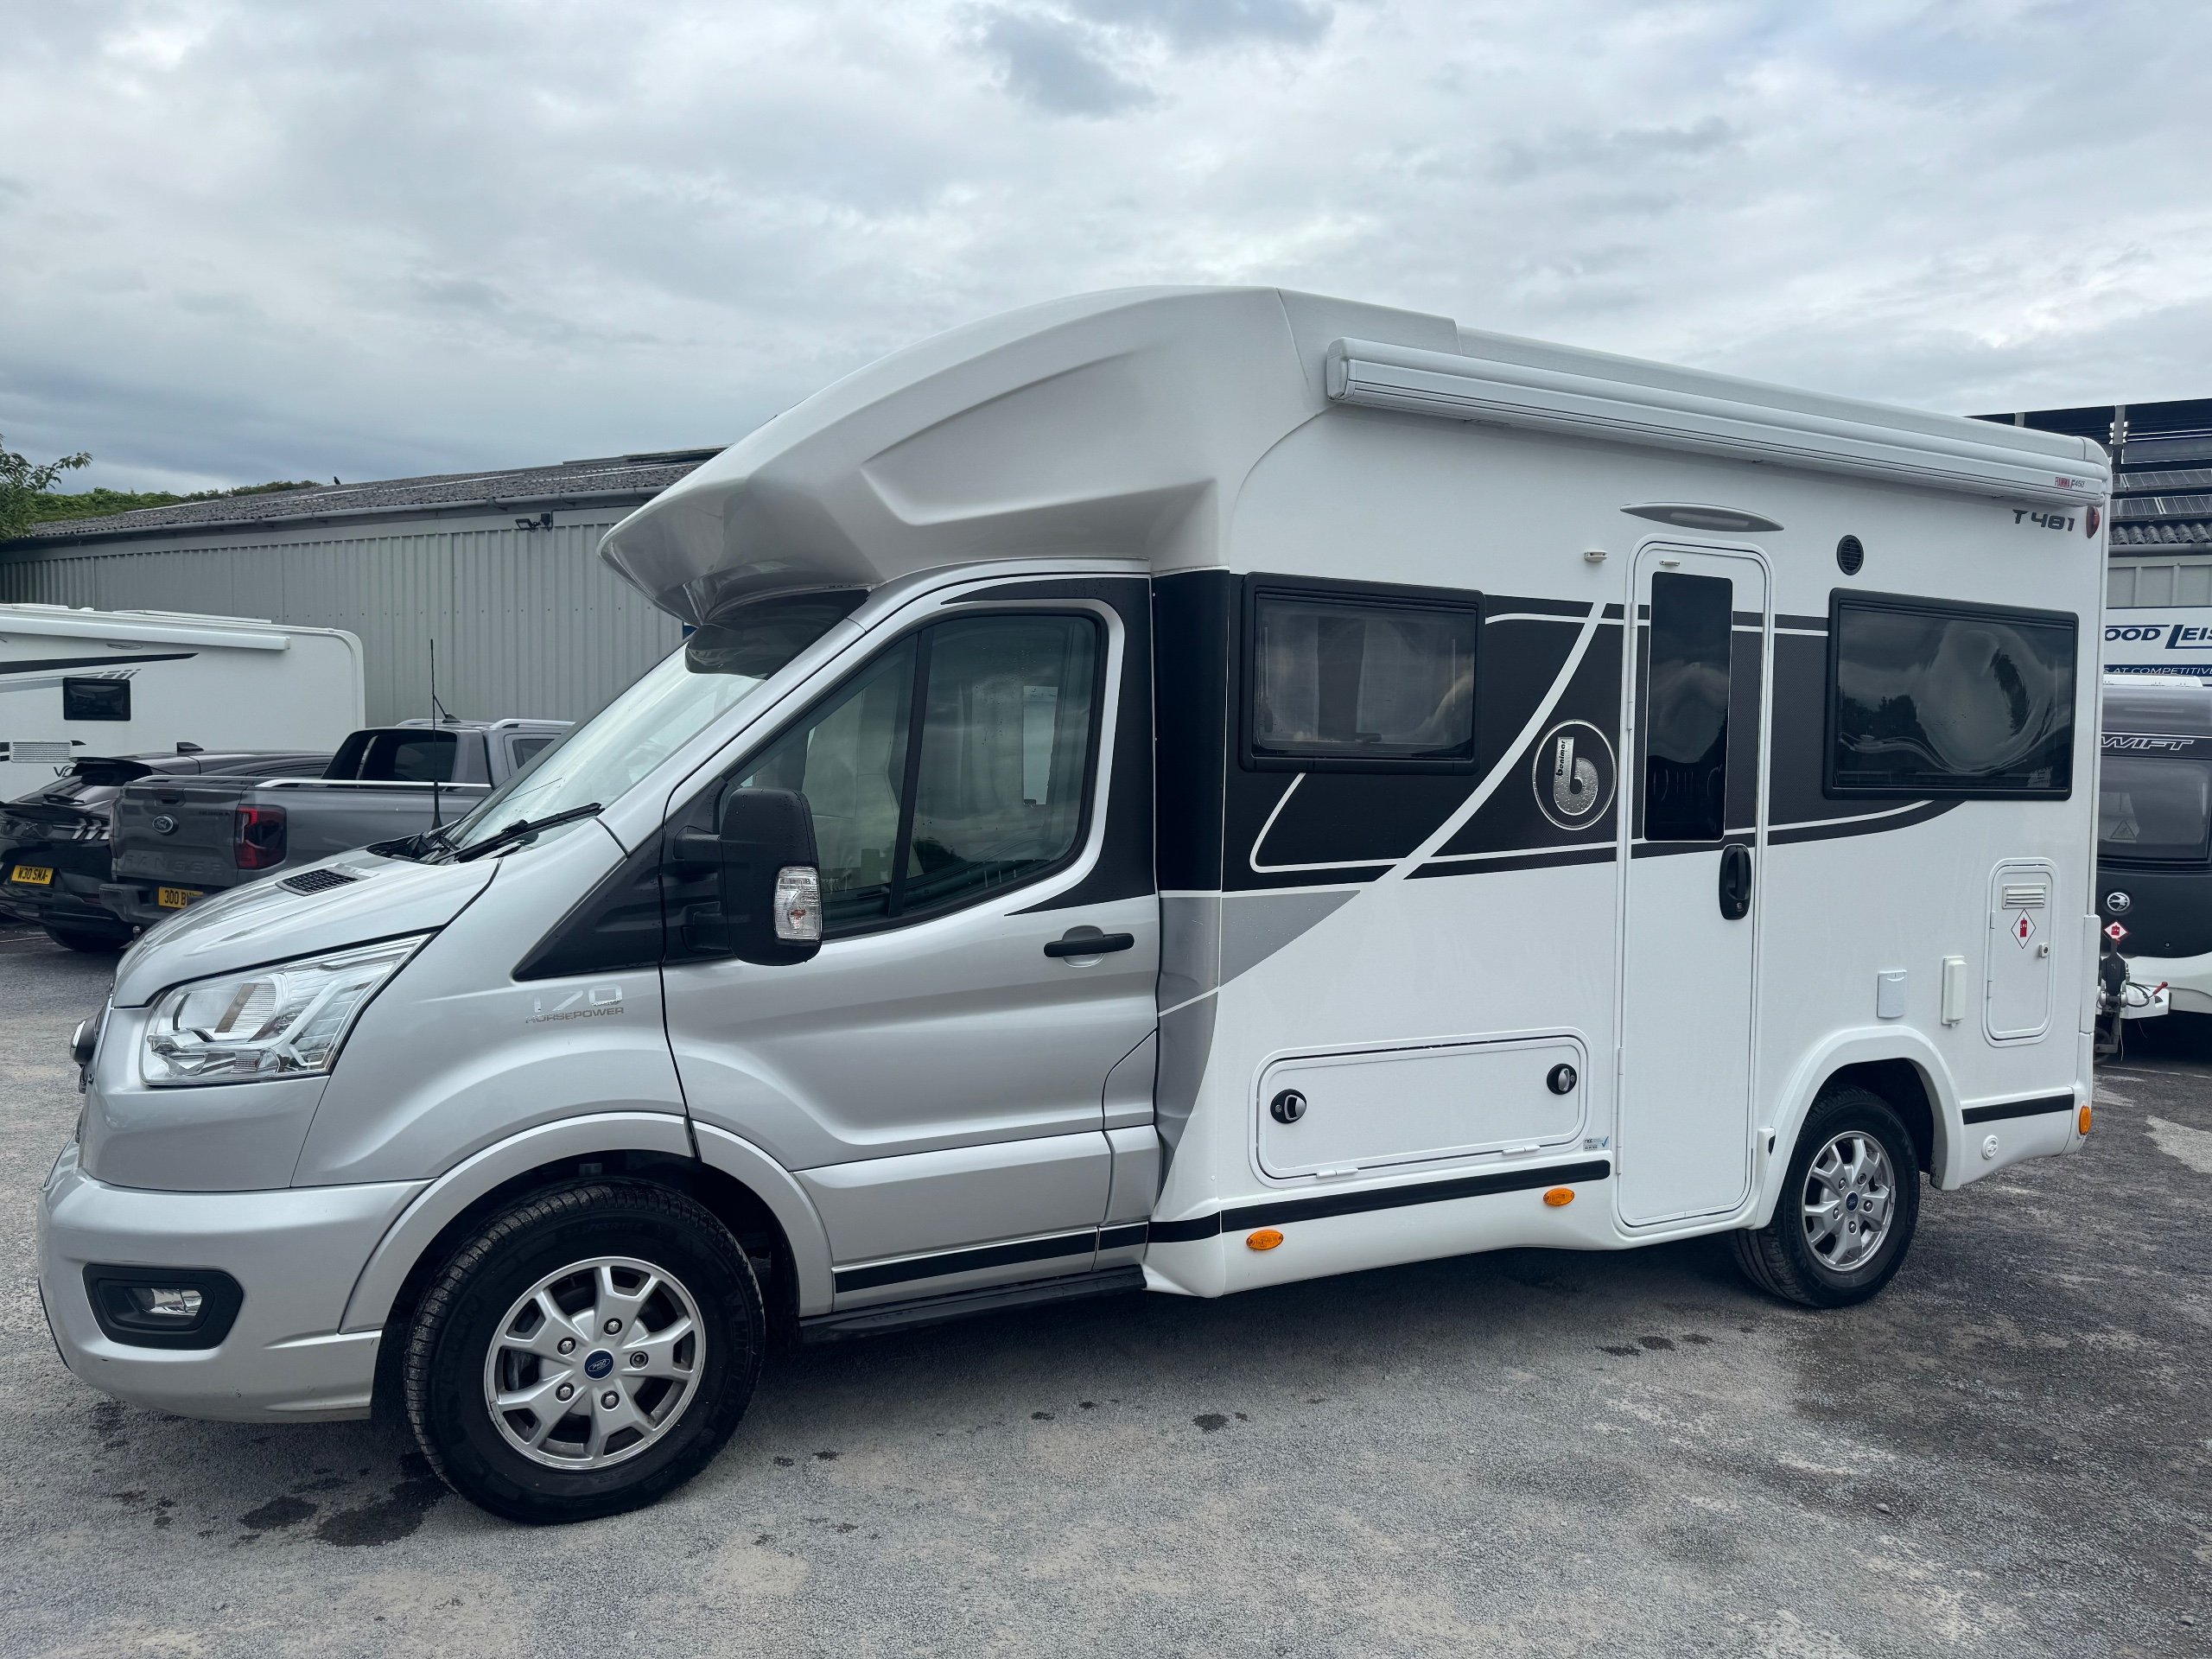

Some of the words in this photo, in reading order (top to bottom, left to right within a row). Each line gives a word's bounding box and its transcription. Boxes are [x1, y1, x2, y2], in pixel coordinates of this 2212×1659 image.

[2012, 509, 2029, 524] T
[2031, 512, 2075, 532] 481
[164, 889, 179, 905] 300
[533, 984, 623, 1013] 170
[524, 1007, 625, 1024] HORSEPOWER
